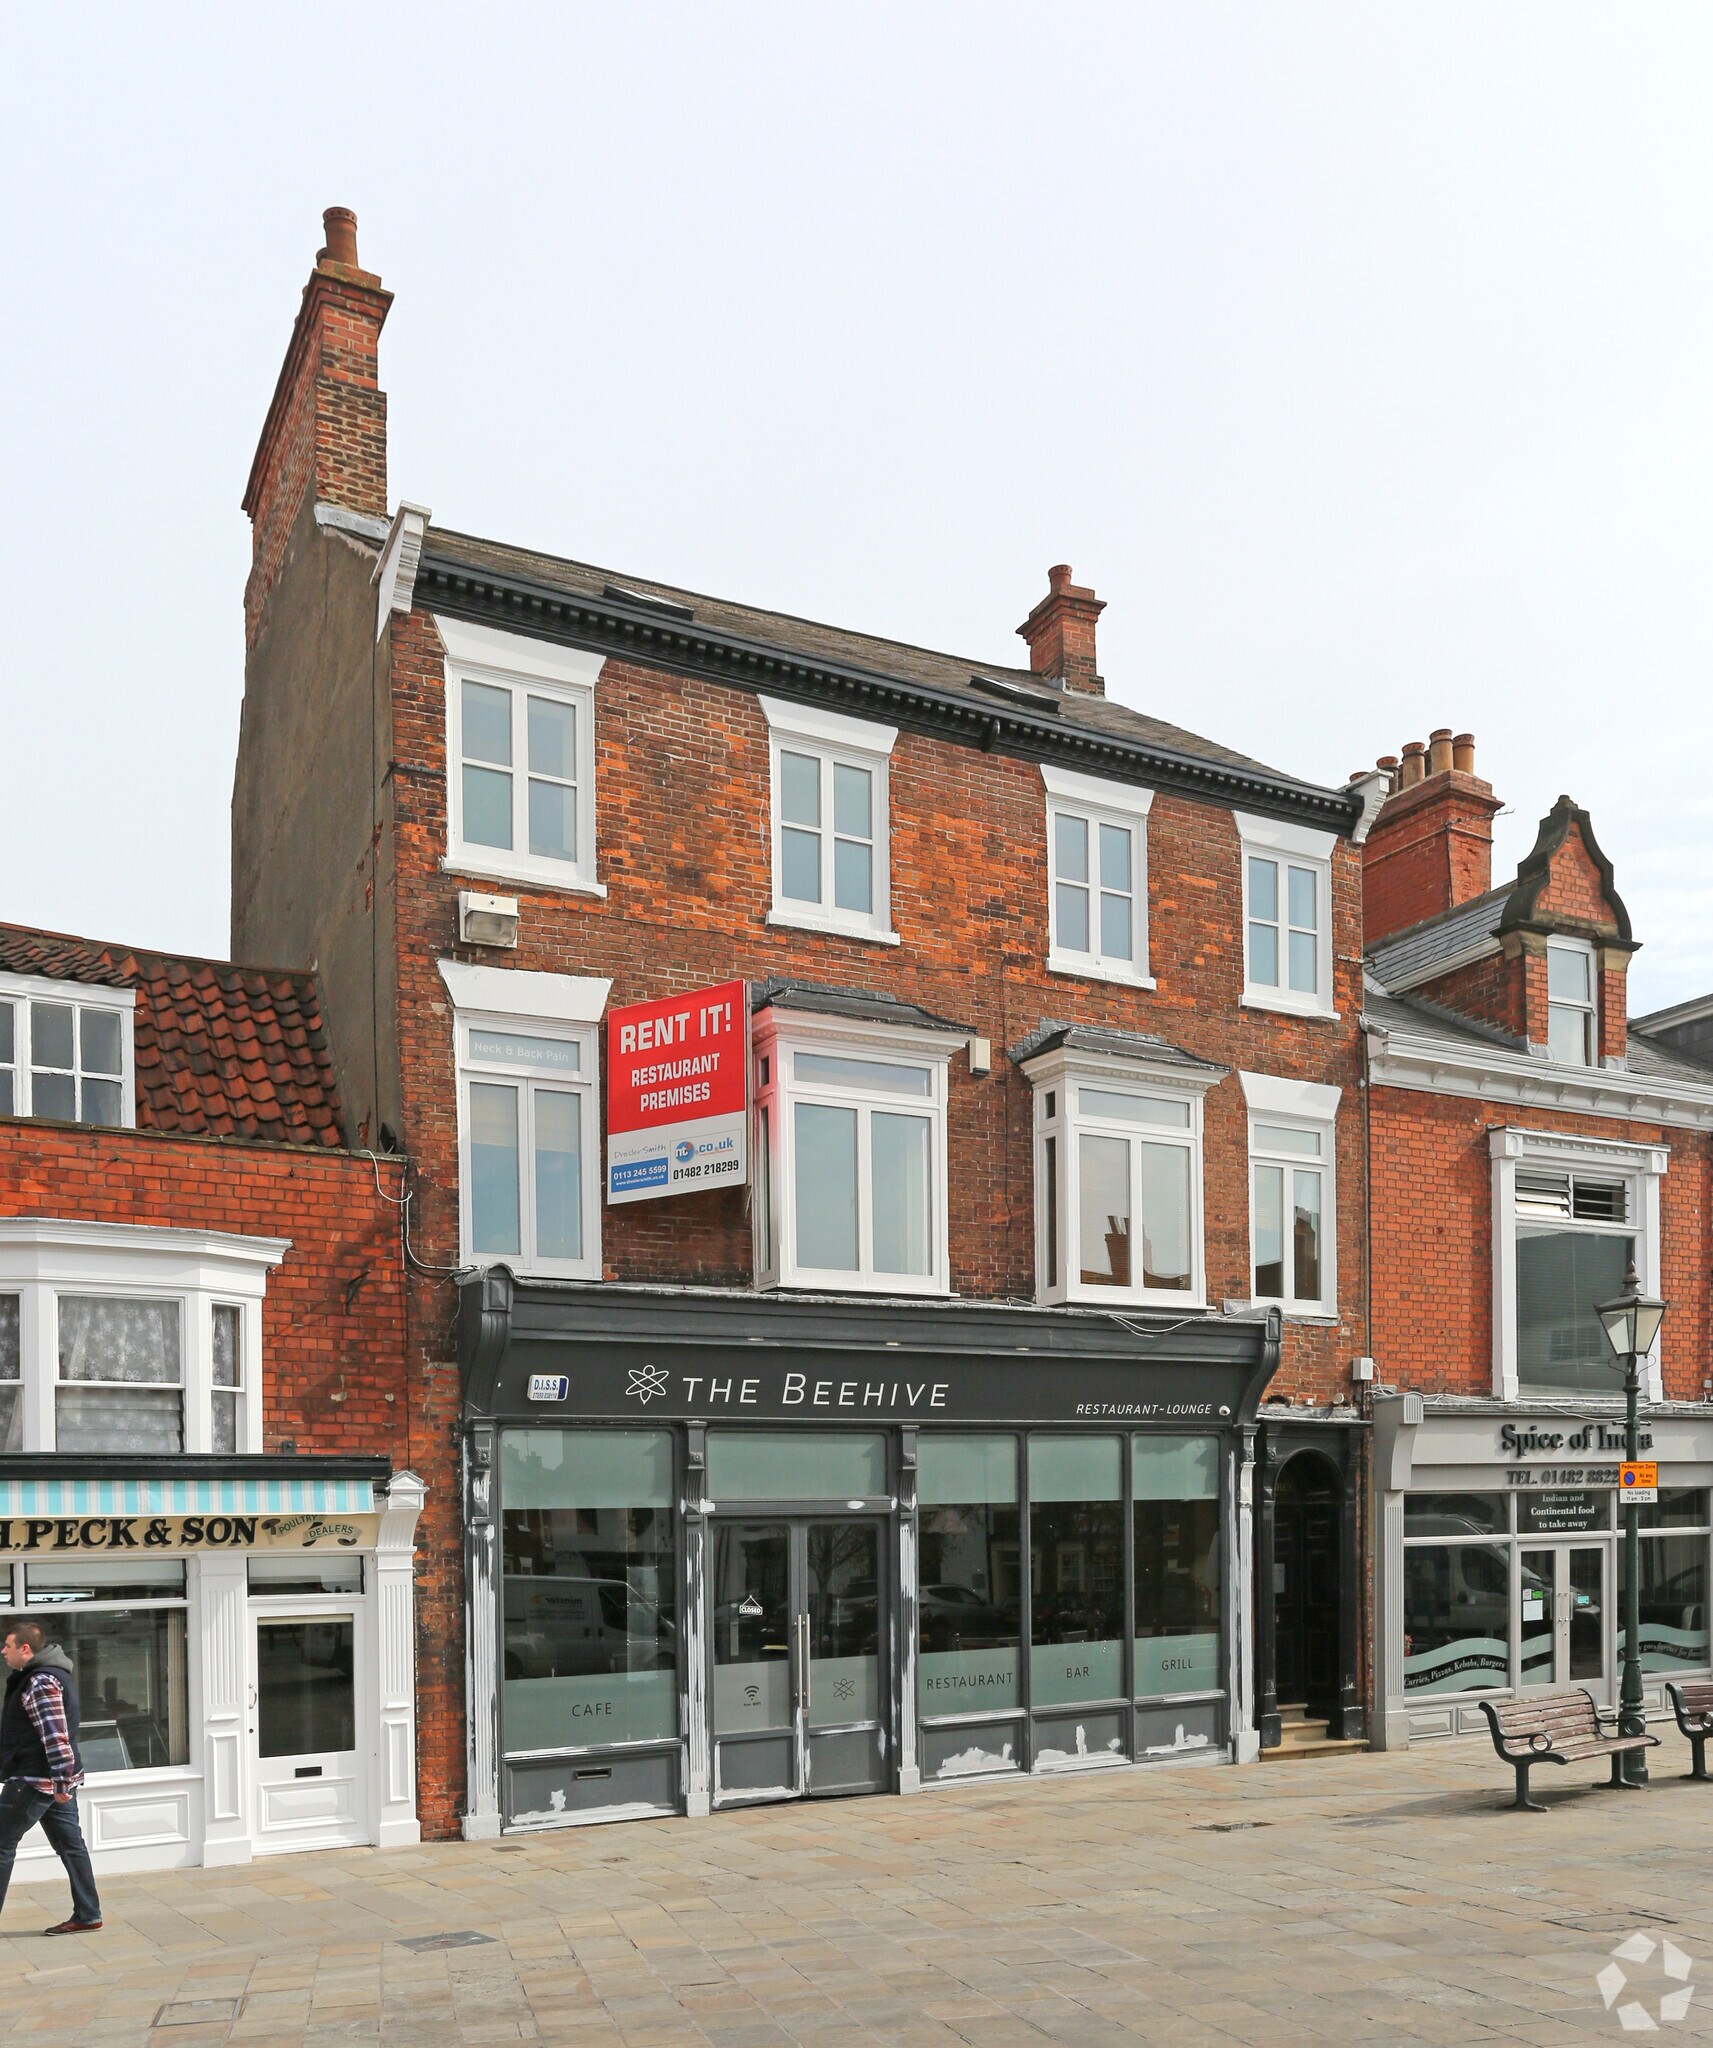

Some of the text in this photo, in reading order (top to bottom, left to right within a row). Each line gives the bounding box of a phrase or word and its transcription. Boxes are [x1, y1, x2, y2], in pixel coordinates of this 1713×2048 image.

[620, 1002, 731, 1054] RENT IT!
[474, 1041, 568, 1062] Neck & Back Pain
[631, 1052, 720, 1087] RESTAURANT
[640, 1082, 710, 1112] PREMISES
[613, 1165, 666, 1180] 0113 245 5599
[673, 1160, 739, 1180] 01482 218299
[534, 1379, 558, 1391] D.I.S.S.
[682, 1373, 949, 1407] THE BEEHIVE
[1501, 1423, 1654, 1457] Spice of Ina
[1506, 1470, 1537, 1485] TEL.
[1541, 1470, 1583, 1484] 01482
[1542, 1494, 1584, 1502] Indian and
[1531, 1506, 1595, 1516] Continental food
[144, 1518, 172, 1545] &
[181, 1516, 259, 1545] SON
[278, 1515, 318, 1535] POULTRY
[308, 1524, 354, 1538] DEALERS
[1568, 1521, 1588, 1529] away
[1066, 1666, 1090, 1678] BAR
[1162, 1658, 1193, 1672] GRILL
[1404, 1657, 1505, 1686] Curries, Pizzas, Kebabs, Burgers
[927, 1672, 1014, 1690] RESTAURANT
[572, 1702, 612, 1718] CAFE
